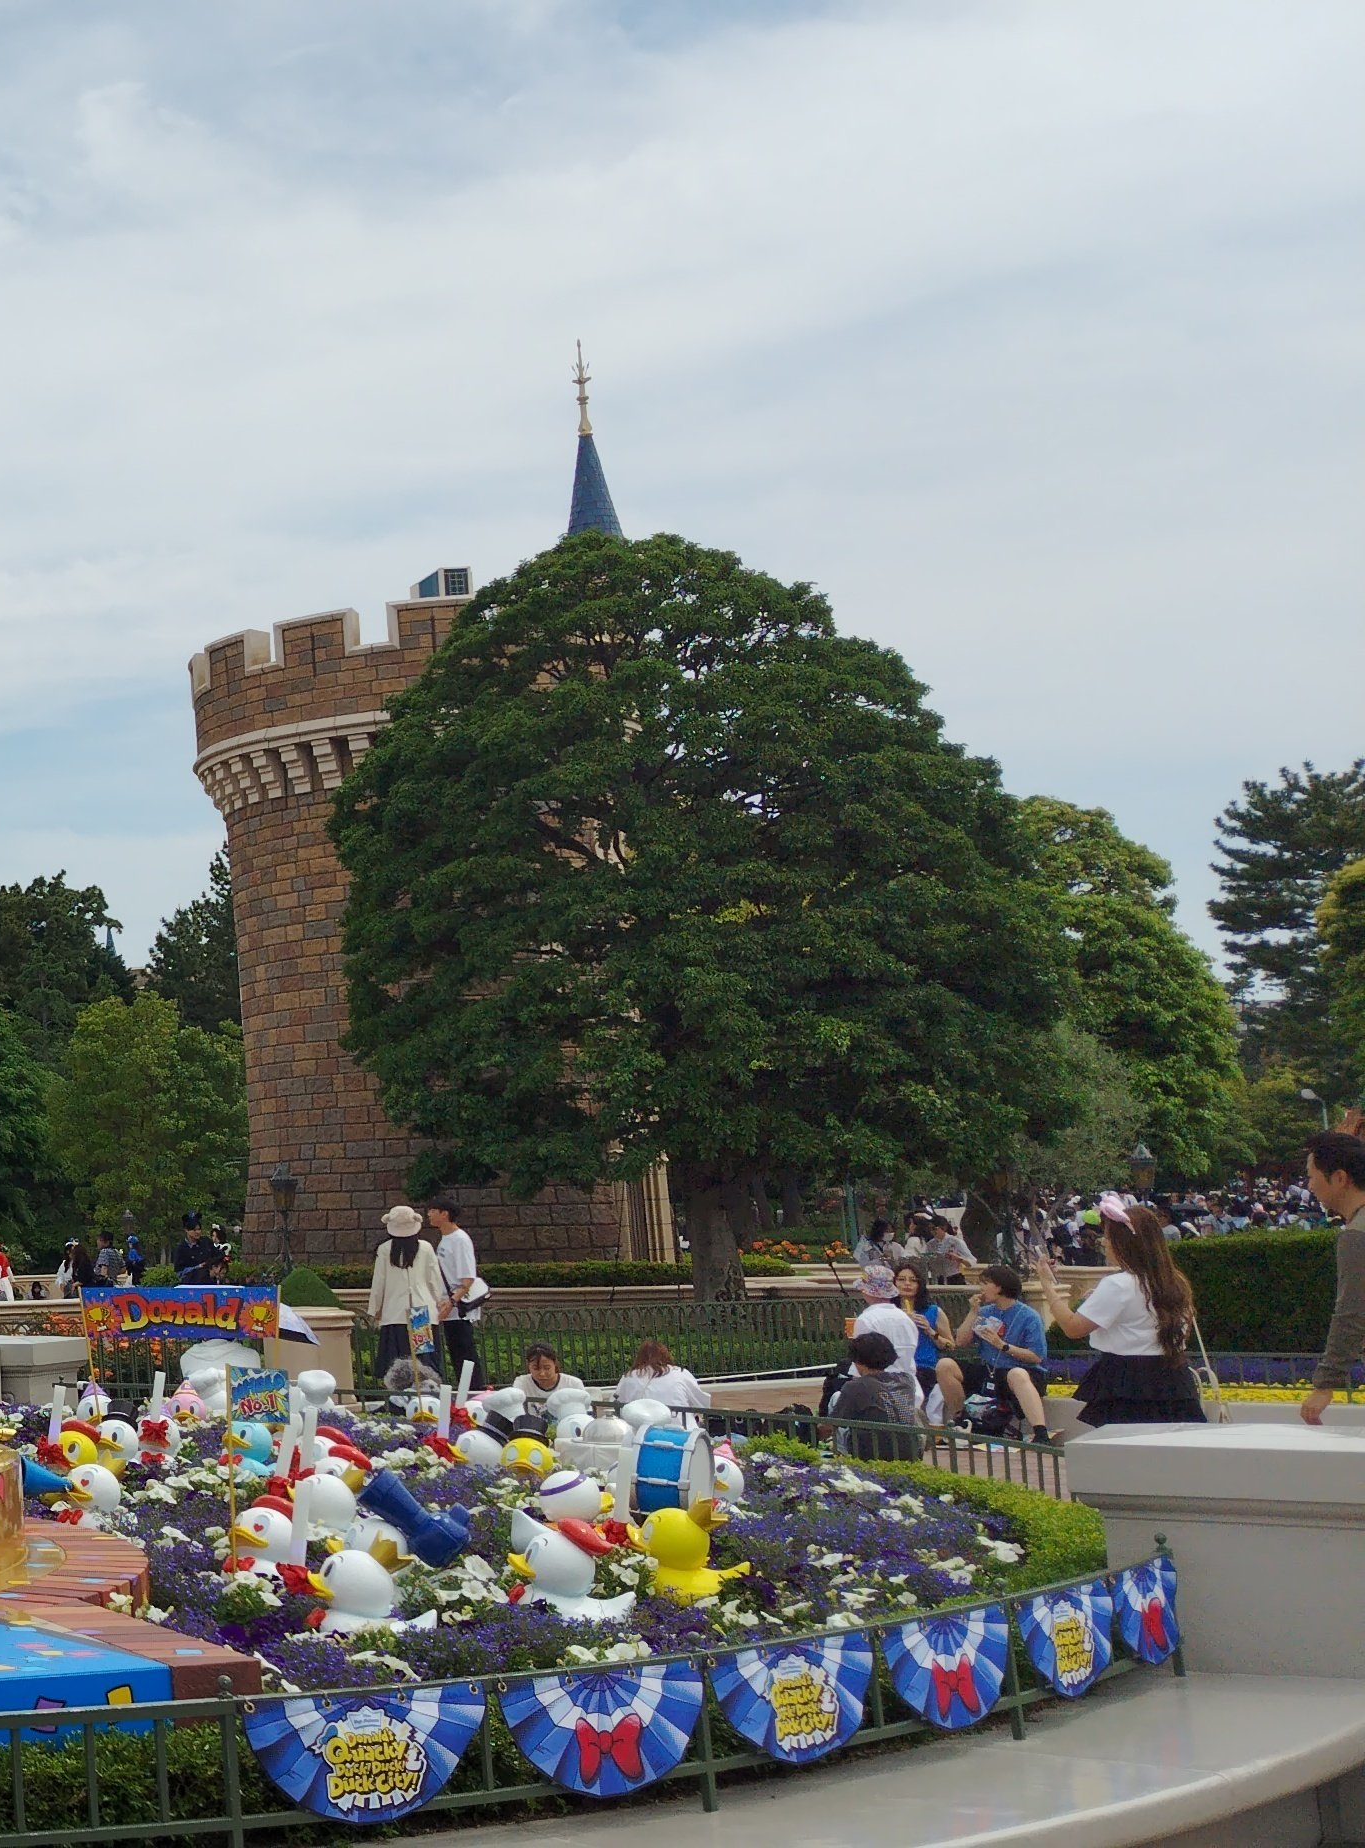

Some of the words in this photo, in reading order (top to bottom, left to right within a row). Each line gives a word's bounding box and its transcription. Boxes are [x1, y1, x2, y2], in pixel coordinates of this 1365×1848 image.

[112, 1293, 243, 1331] Donald
[239, 1392, 278, 1417] No.1
[326, 1737, 408, 1763] Quacky
[329, 1776, 375, 1798] Duck
[376, 1772, 418, 1794] City!
